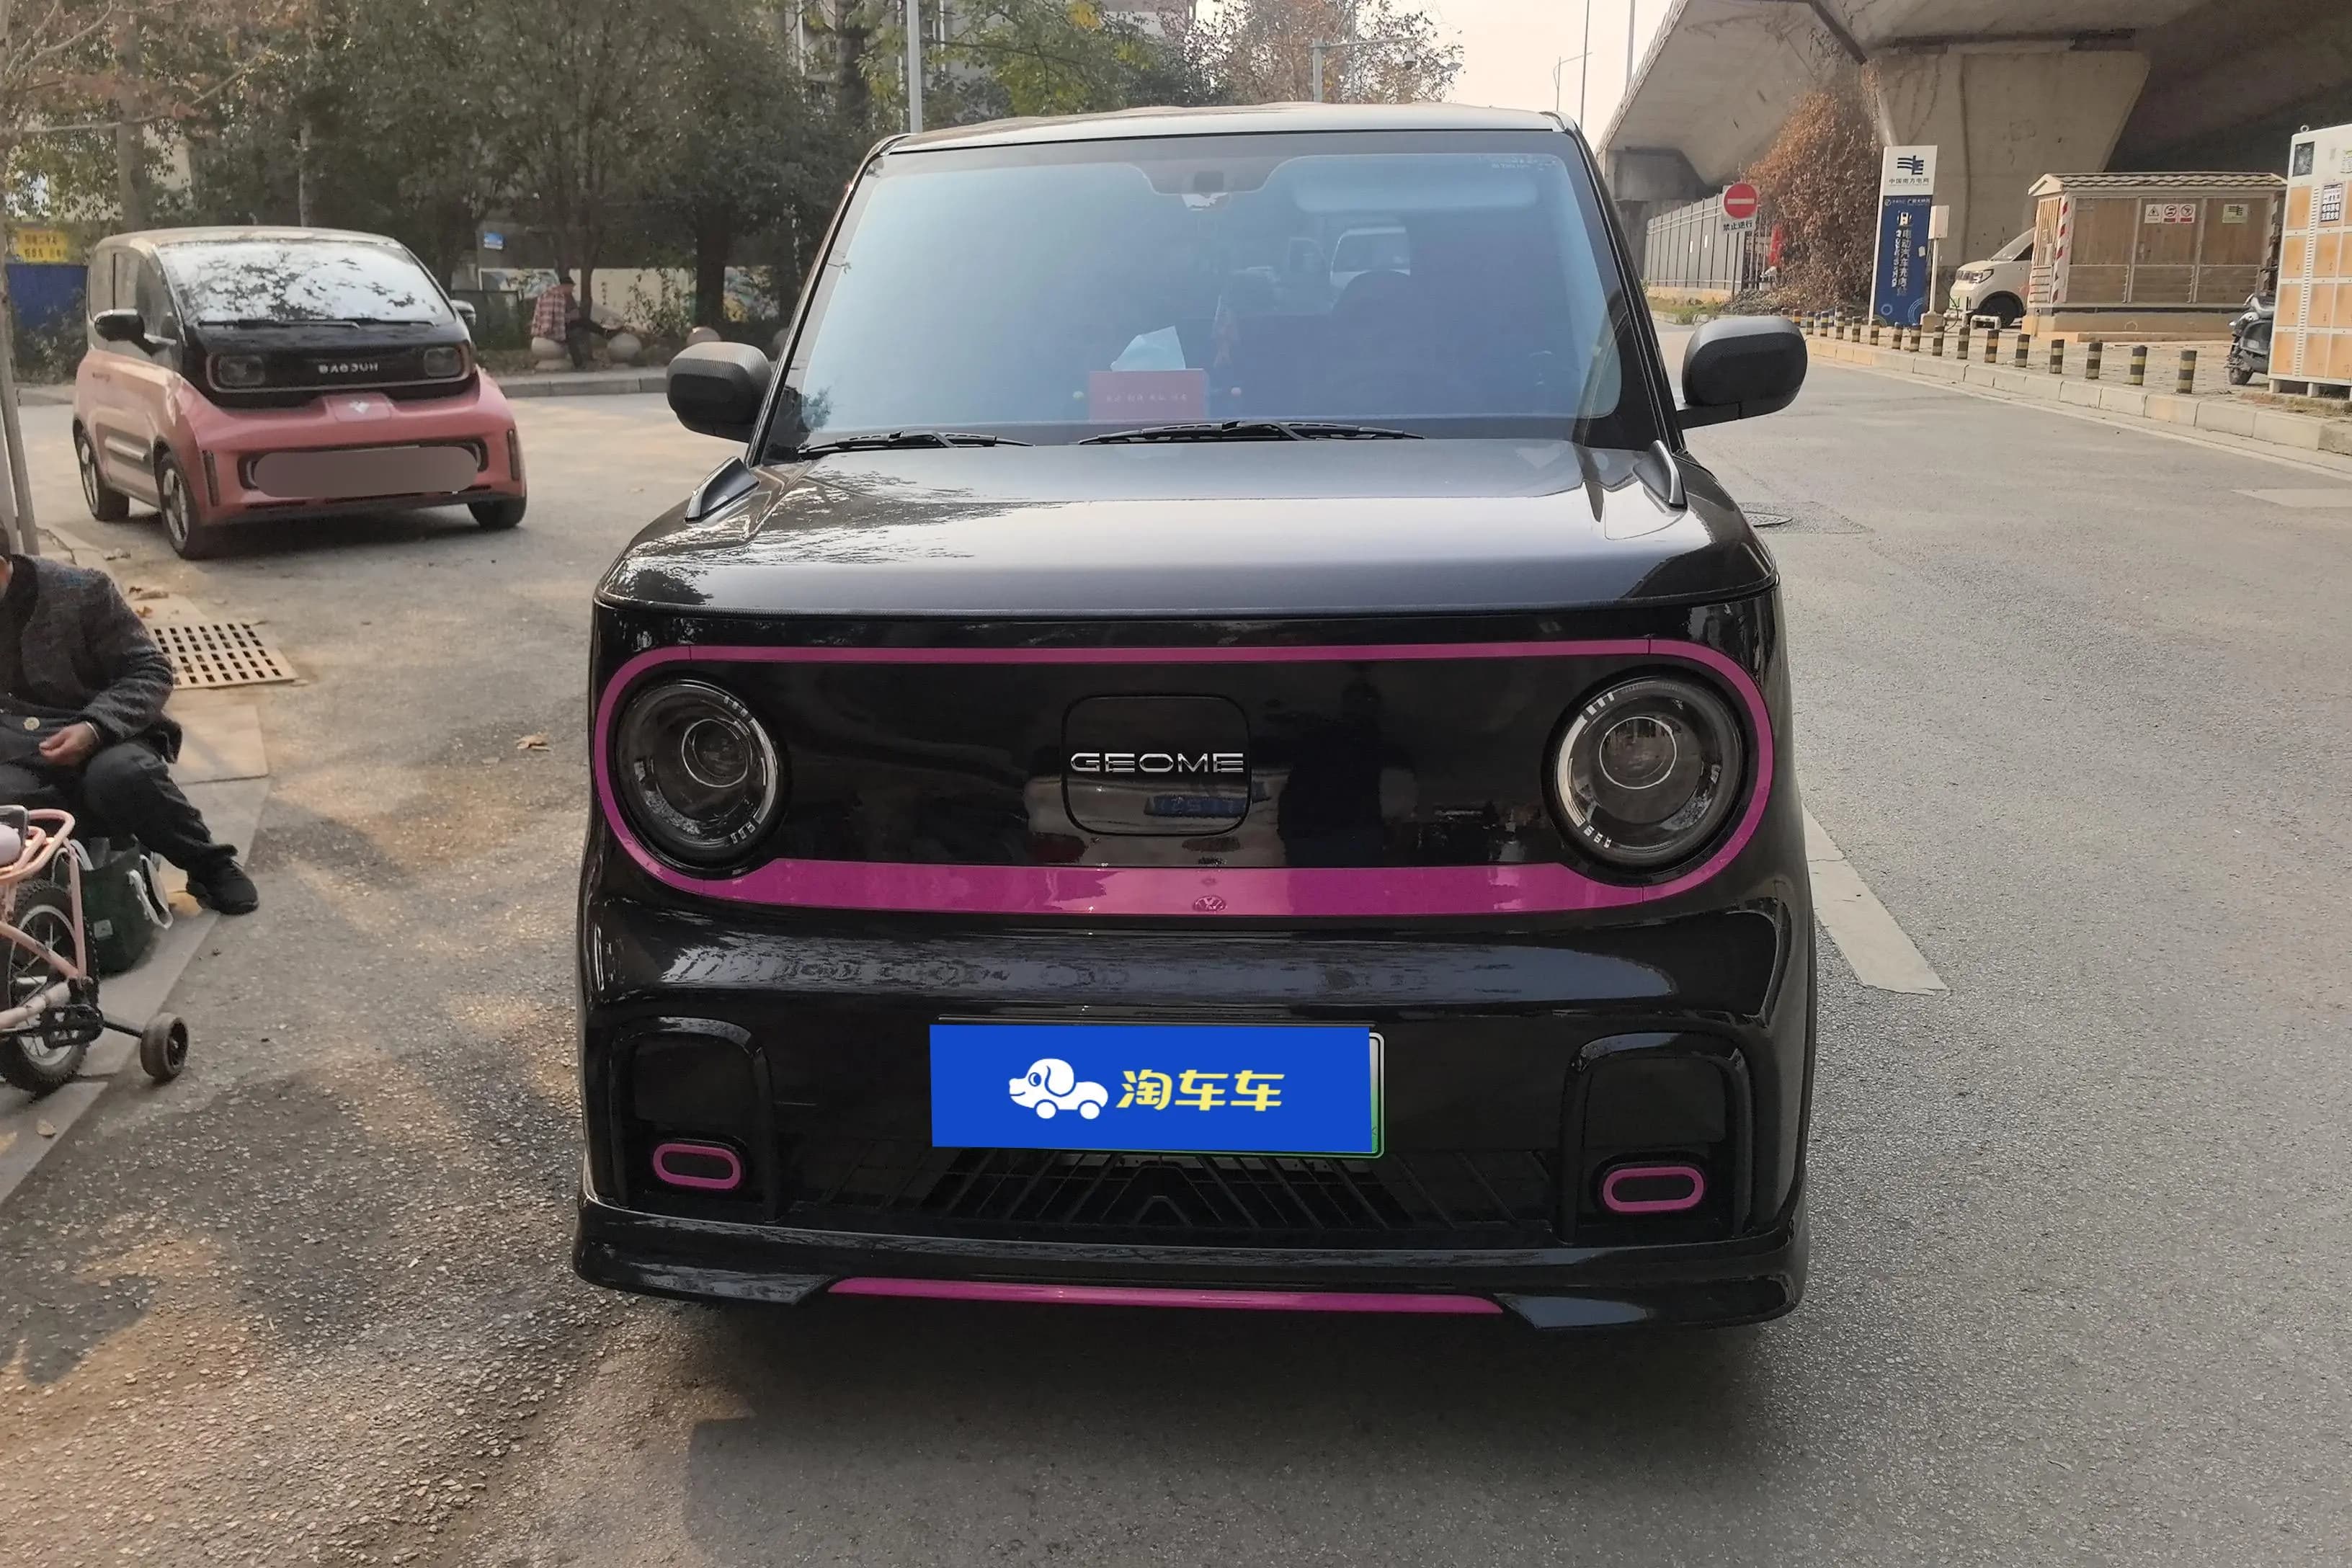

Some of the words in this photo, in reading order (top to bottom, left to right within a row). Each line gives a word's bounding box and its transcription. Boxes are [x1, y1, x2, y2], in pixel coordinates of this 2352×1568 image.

[1723, 220, 1753, 231] 禁止逆行
[318, 362, 378, 373] BAOJUN
[1071, 753, 1244, 772] GEOME
